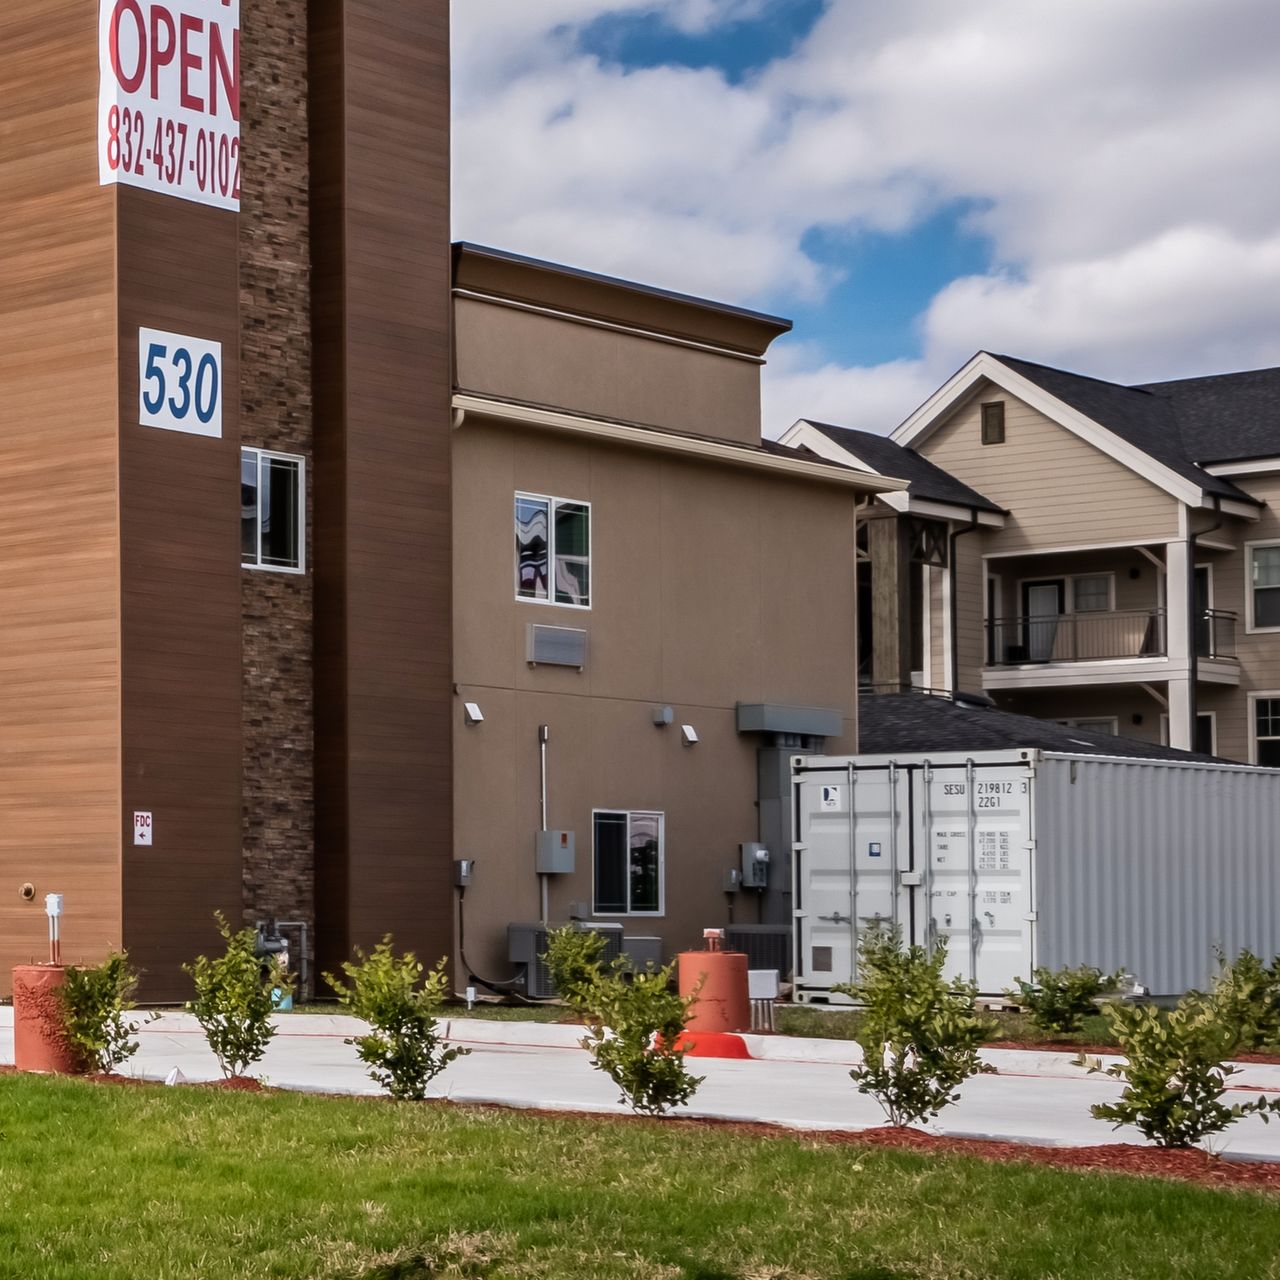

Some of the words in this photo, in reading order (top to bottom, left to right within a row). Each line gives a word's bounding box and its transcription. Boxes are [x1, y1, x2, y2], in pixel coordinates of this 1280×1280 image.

[107, 104, 240, 201] 832-437-0102
[142, 342, 219, 424] 530
[944, 784, 965, 795] SESU
[977, 782, 1012, 794] 219812
[1021, 782, 1028, 794] 3
[978, 796, 1000, 808] 22G1
[135, 814, 151, 828] FDC
